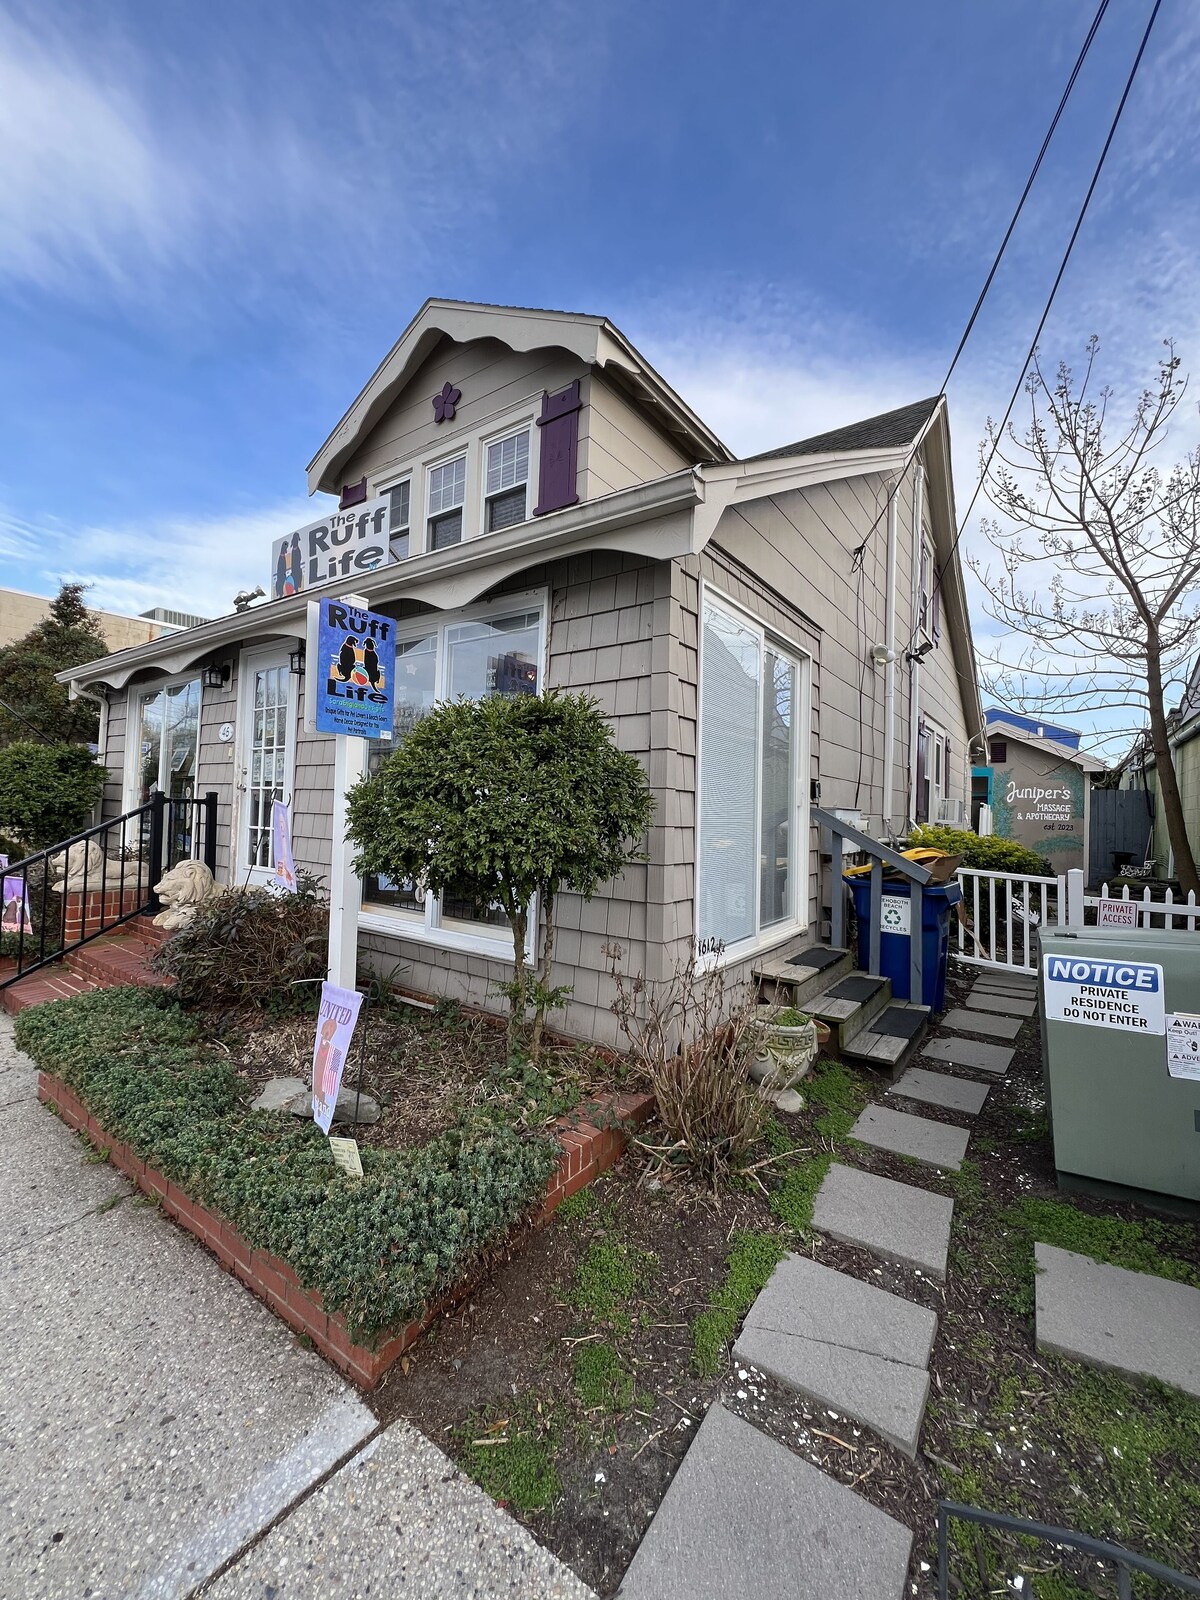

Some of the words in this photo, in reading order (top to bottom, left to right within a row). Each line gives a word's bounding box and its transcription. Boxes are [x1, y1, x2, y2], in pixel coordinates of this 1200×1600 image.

[330, 513, 356, 529] The
[309, 506, 388, 557] Ruff
[309, 546, 385, 585] Life
[328, 603, 391, 641] Ruff
[348, 606, 369, 621] The
[327, 678, 389, 704] Life
[1007, 781, 1071, 804] Juniper's
[1017, 812, 1023, 820] &
[1025, 812, 1070, 821] APOTHECARY
[1037, 803, 1072, 813] MASSAGE
[1043, 822, 1055, 831] est
[1057, 823, 1074, 832] 2023
[1102, 903, 1134, 914] PRIVATE
[1102, 913, 1132, 925] ACCESS
[1052, 960, 1155, 988] NOTICE
[1080, 985, 1129, 1000] PRIVATE
[320, 999, 352, 1025] UNITED
[1071, 996, 1140, 1014] RESIDENCE
[1063, 1007, 1080, 1018] DO
[1083, 1010, 1107, 1022] NOT
[1109, 1014, 1148, 1028] ENTER
